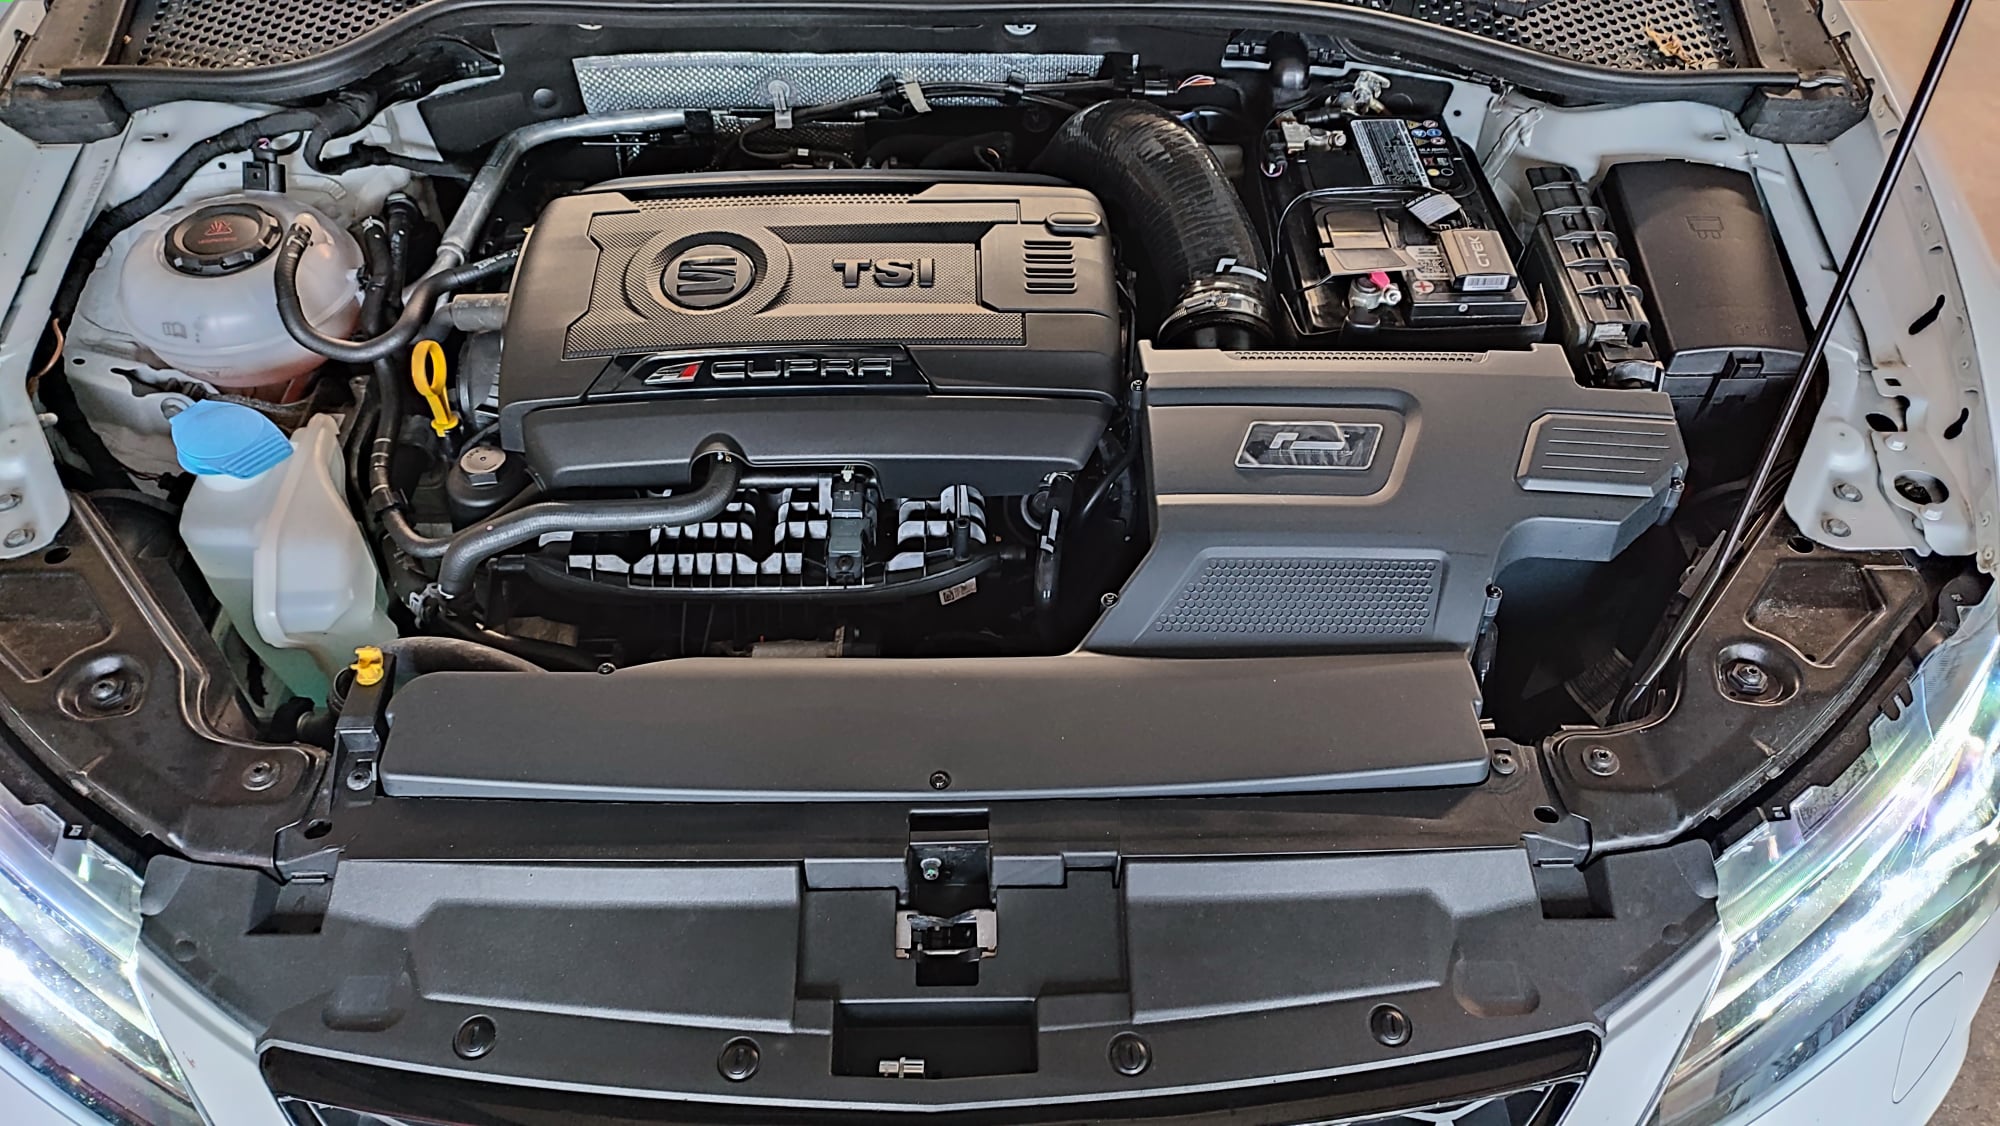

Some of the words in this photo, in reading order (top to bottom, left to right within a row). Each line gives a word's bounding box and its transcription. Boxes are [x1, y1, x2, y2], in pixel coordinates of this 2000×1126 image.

[1468, 235, 1490, 268] CTEK
[832, 257, 935, 288] TSI
[711, 356, 893, 380] CUPRA
